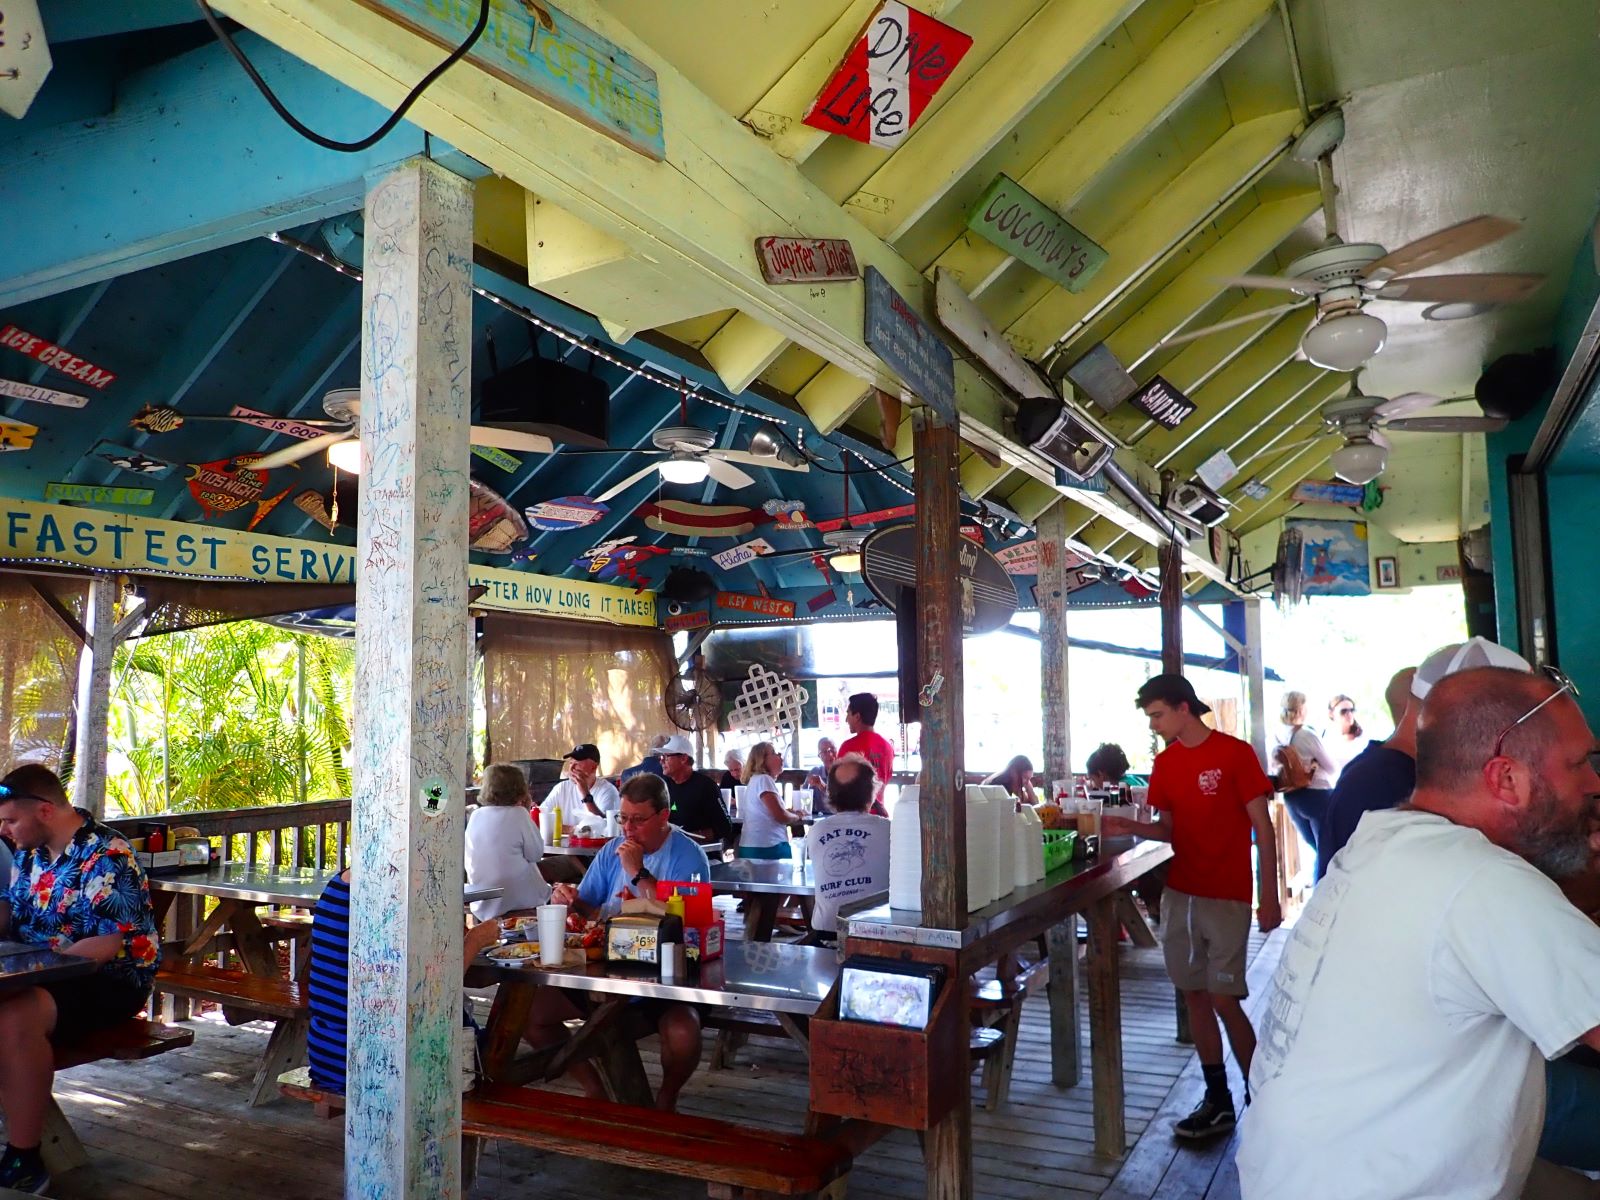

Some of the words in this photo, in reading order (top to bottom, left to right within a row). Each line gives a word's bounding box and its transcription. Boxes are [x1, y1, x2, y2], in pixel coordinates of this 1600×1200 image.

[765, 236, 816, 278] Jupiter
[818, 239, 852, 276] Inlet
[1, 327, 42, 353] ICE
[38, 346, 114, 388] CREAM
[271, 420, 286, 430] IS
[289, 426, 325, 440] GOO
[198, 469, 229, 489] KIDS
[224, 480, 264, 500] NIGHT
[7, 511, 227, 571] FASTEST
[251, 544, 357, 584] SERVI
[719, 549, 751, 567] Aloha
[526, 585, 553, 605] HOW
[559, 589, 590, 609] LONG
[601, 597, 611, 613] IT
[728, 595, 747, 609] KEY
[753, 598, 782, 613] WEST
[819, 828, 841, 845] FAT
[845, 828, 872, 840] BOY
[820, 880, 842, 893] SURF
[844, 876, 872, 887] CLUB
